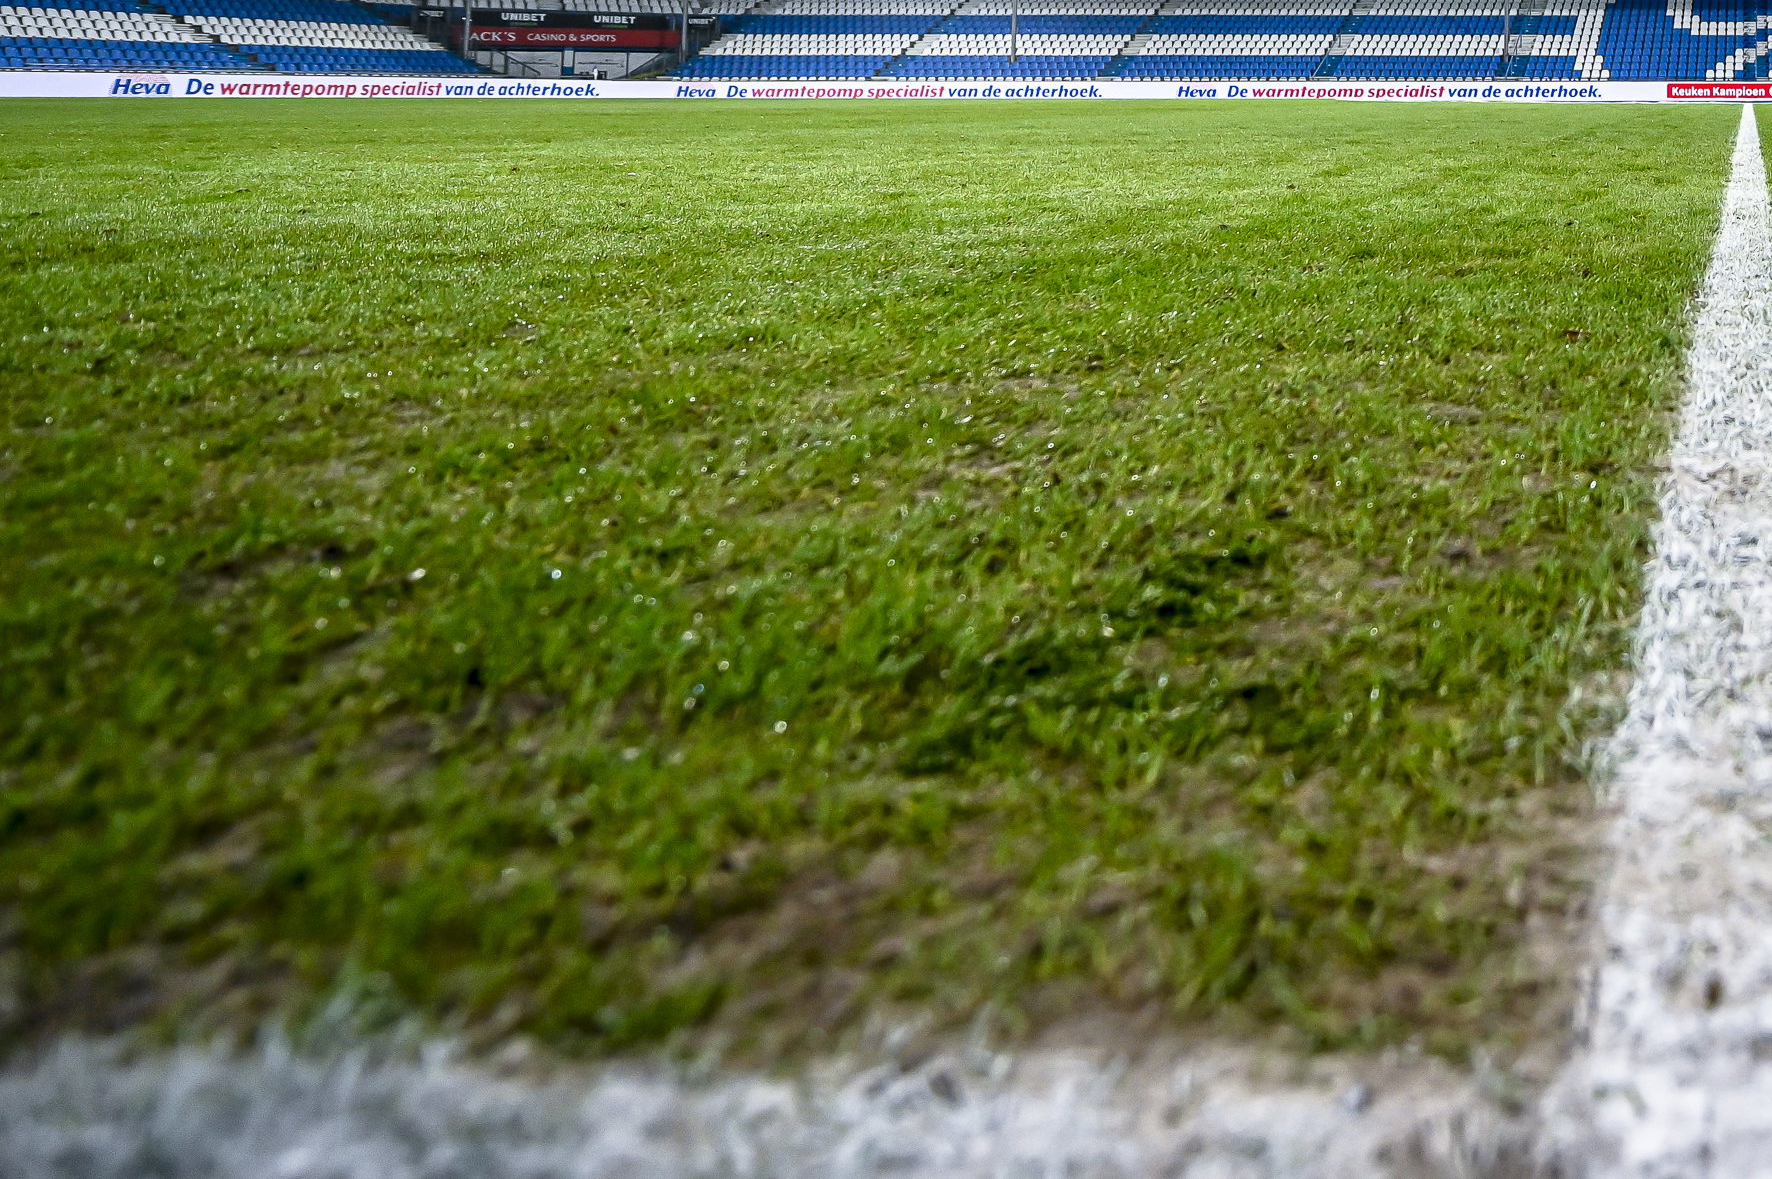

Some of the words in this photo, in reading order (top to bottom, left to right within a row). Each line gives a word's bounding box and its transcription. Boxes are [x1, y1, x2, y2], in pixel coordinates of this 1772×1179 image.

[501, 12, 546, 22] UNIBET
[593, 15, 636, 25] UNIBET
[470, 30, 517, 43] ACK'S
[527, 32, 568, 42] CASINO
[568, 33, 578, 42] &
[580, 33, 617, 43] SPORTS
[112, 78, 170, 95] Heva
[186, 78, 214, 95] De
[220, 81, 356, 98] warmtepomp
[361, 80, 442, 98] specialist
[446, 85, 473, 96] van
[478, 82, 495, 95] de
[499, 82, 600, 97] achterhoek.
[677, 85, 715, 98] Heva
[727, 85, 747, 98] De
[752, 85, 863, 99] warmtepomp
[867, 85, 944, 99] specialist
[948, 87, 978, 97] van
[982, 85, 1001, 97] de
[1005, 85, 1102, 98] achterhoek.
[1178, 85, 1216, 98] Heva
[1228, 85, 1248, 98] De
[1252, 85, 1363, 99] warmtepomp
[1368, 85, 1444, 99] specialist
[1448, 87, 1478, 97] van
[1482, 85, 1501, 97] de
[1505, 85, 1602, 98] achterhoek.
[1671, 85, 1711, 97] Keuken
[1712, 85, 1766, 99] Kampioen
